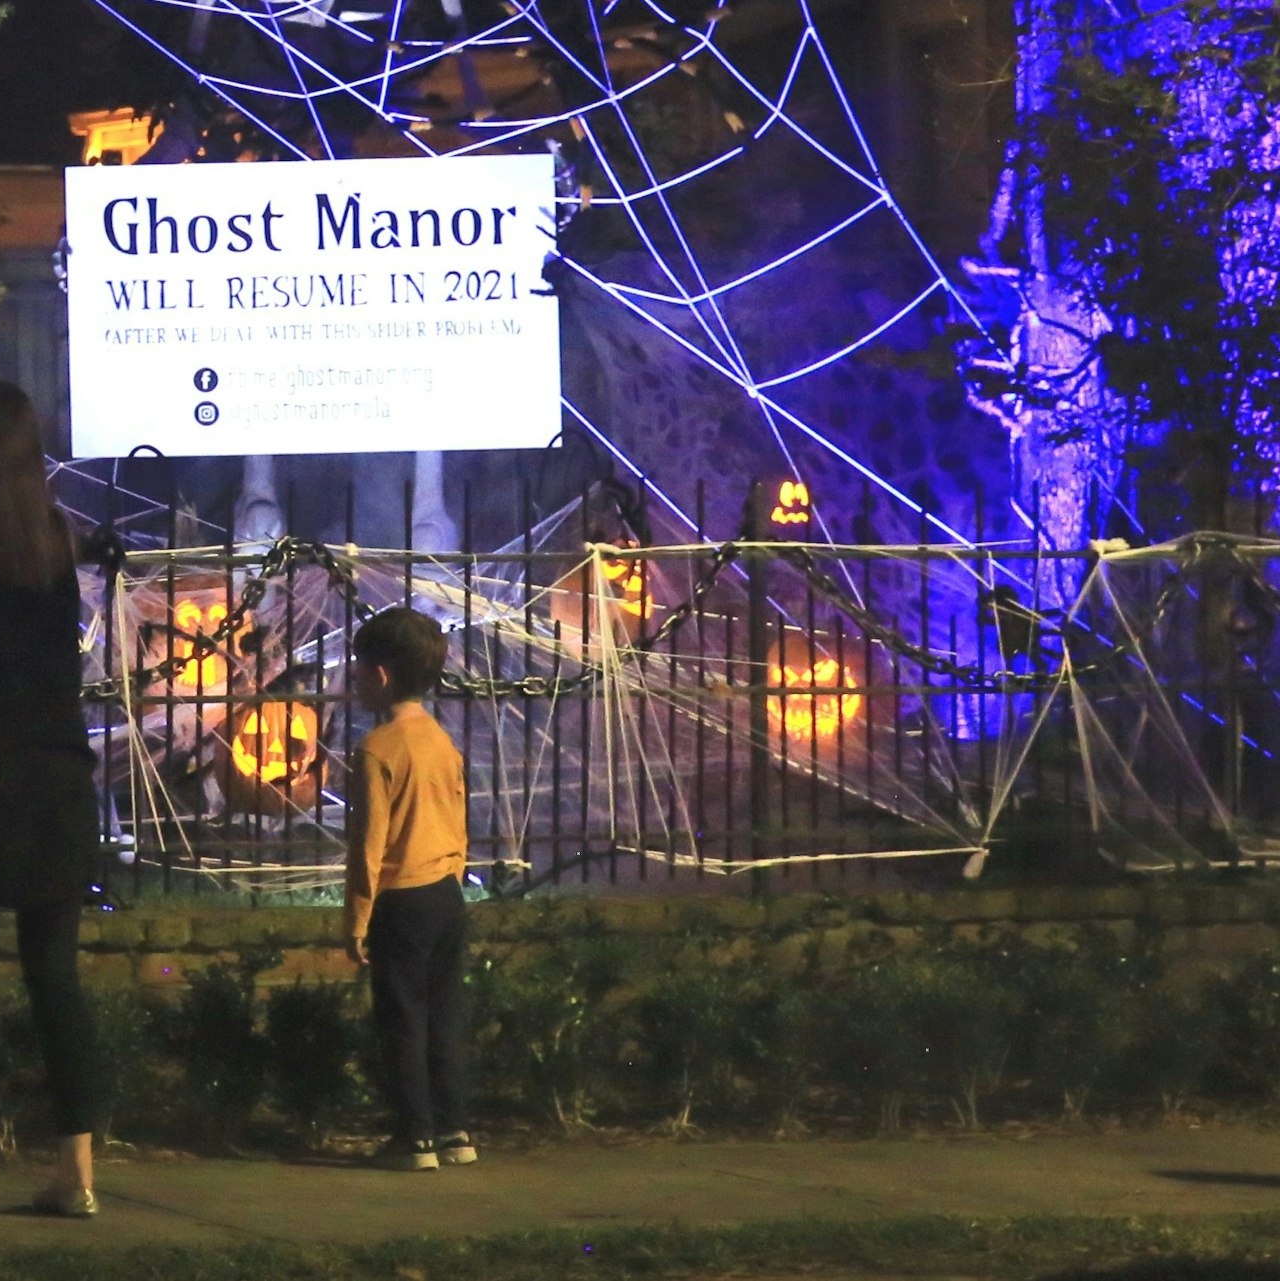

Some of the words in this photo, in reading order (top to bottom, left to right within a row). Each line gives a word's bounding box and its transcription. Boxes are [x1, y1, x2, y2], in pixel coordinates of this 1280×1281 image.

[104, 197, 283, 255] Ghost
[316, 193, 516, 249] Manor
[106, 280, 205, 310] WILL
[227, 274, 368, 309] RESUME
[391, 272, 424, 303] IN
[444, 270, 517, 302] 2021
[105, 328, 165, 344] (AFTER
[175, 328, 200, 343] WE
[266, 324, 312, 340] WITH
[321, 324, 360, 339] THIS
[368, 321, 426, 338] SPIDER
